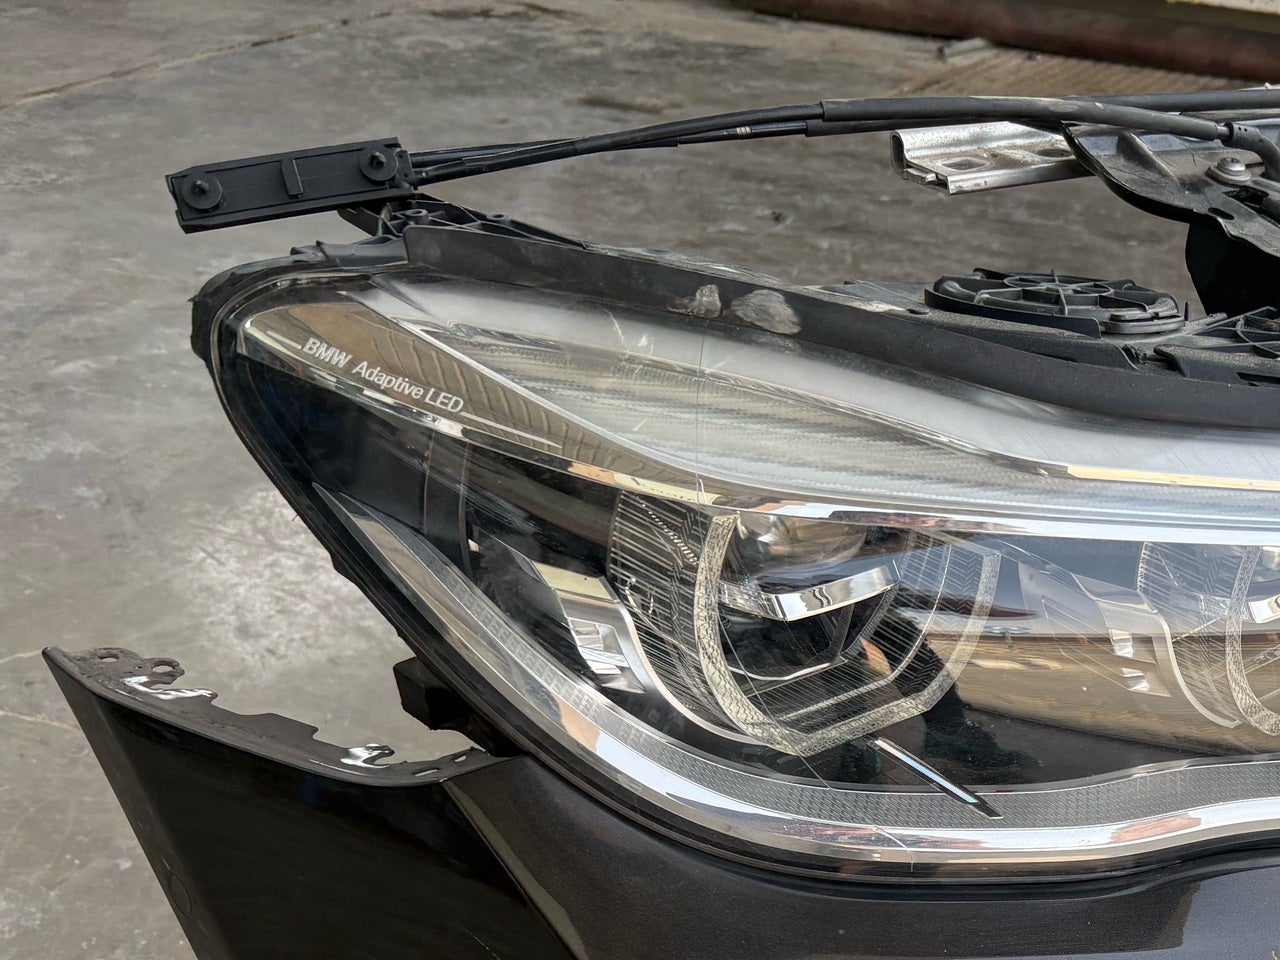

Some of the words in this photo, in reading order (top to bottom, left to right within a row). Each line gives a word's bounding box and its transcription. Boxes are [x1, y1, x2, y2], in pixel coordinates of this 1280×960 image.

[302, 337, 354, 368] BMW
[352, 361, 424, 400] Adaptive
[424, 388, 465, 414] LED
